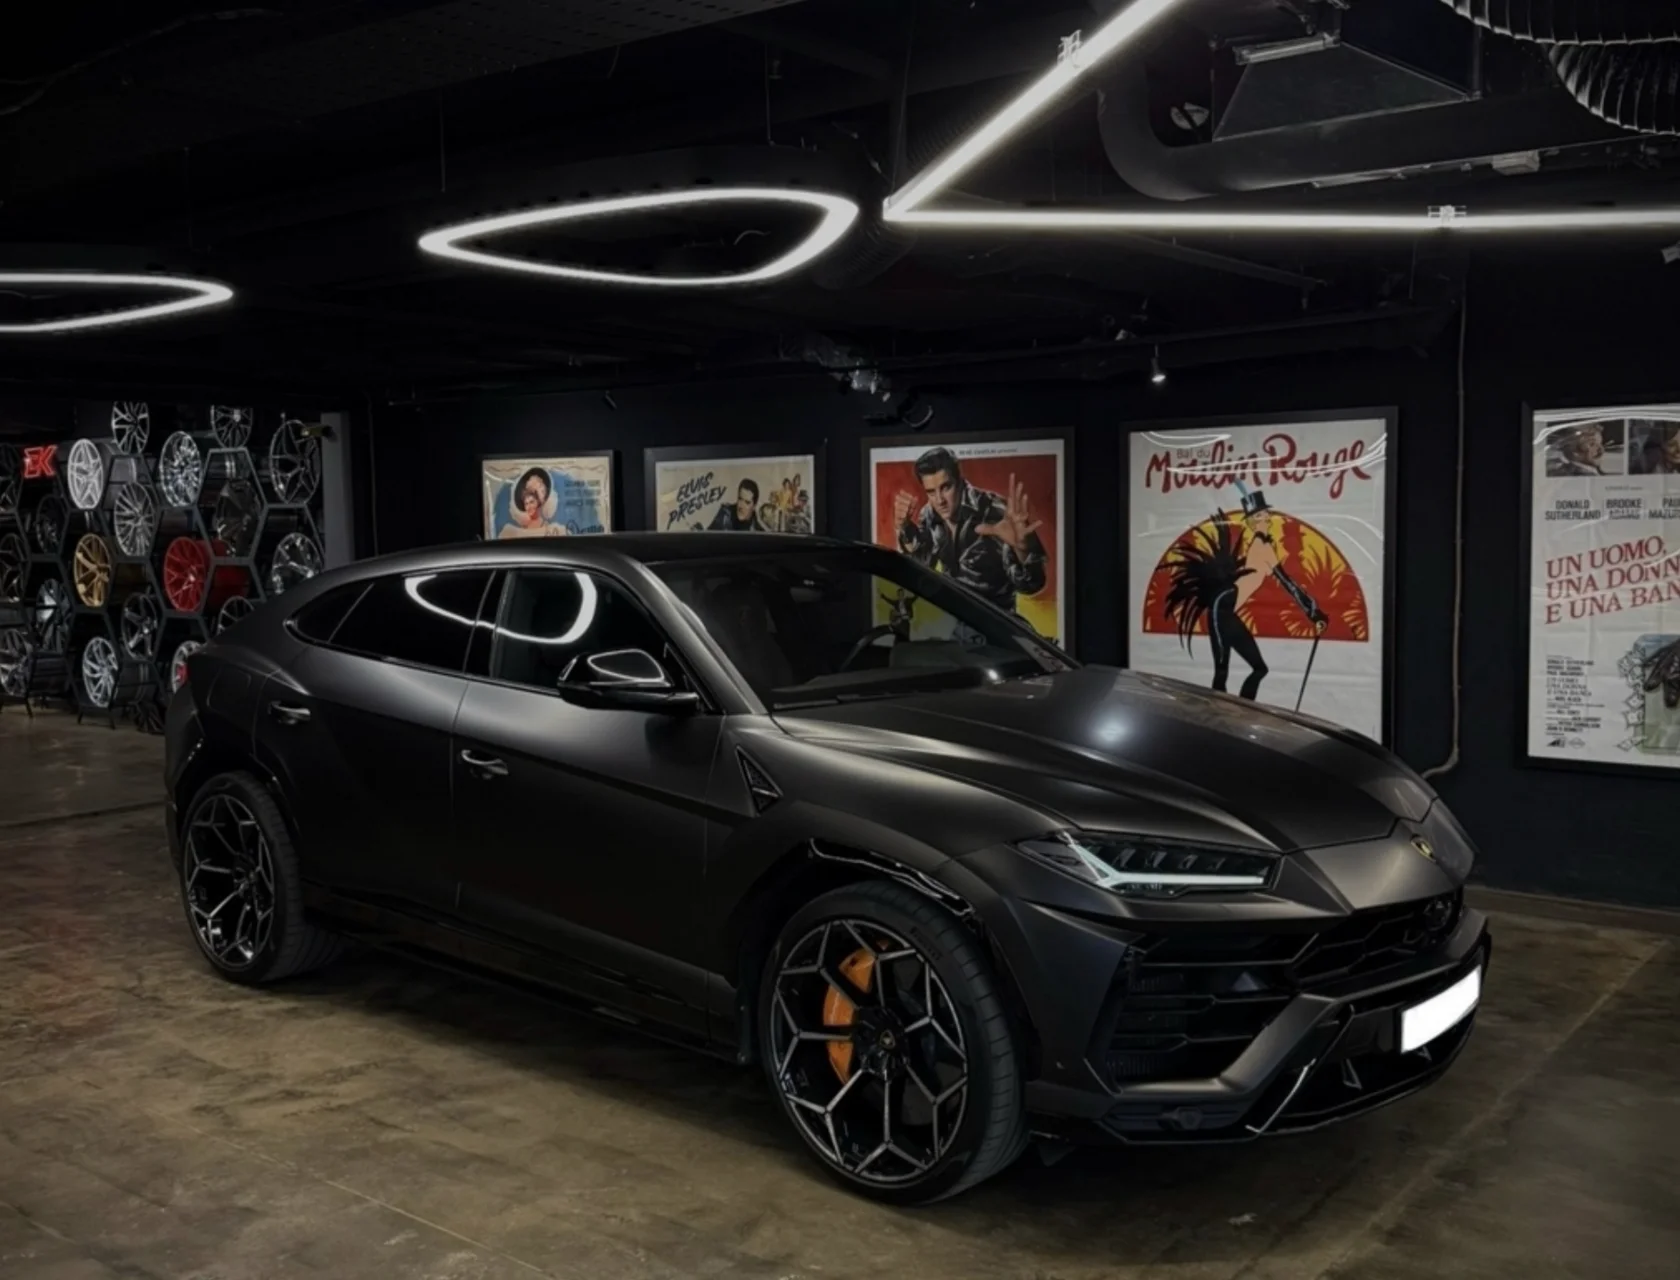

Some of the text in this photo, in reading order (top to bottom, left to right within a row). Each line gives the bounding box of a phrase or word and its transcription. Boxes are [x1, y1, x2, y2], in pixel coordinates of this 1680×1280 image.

[1145, 434, 1372, 500] Moulin Rouge
[1176, 447, 1210, 459] Bal du
[677, 471, 715, 503] ELVIS
[668, 485, 727, 531] PRESLEY
[1545, 509, 1601, 520] SUTHERLAND
[1555, 499, 1590, 509] DONALD
[1606, 498, 1642, 508] BROOKE
[1545, 535, 1667, 579] UN UOMO,
[1546, 573, 1599, 600] UNA
[1544, 603, 1562, 625] E
[1569, 592, 1623, 619] UNA
